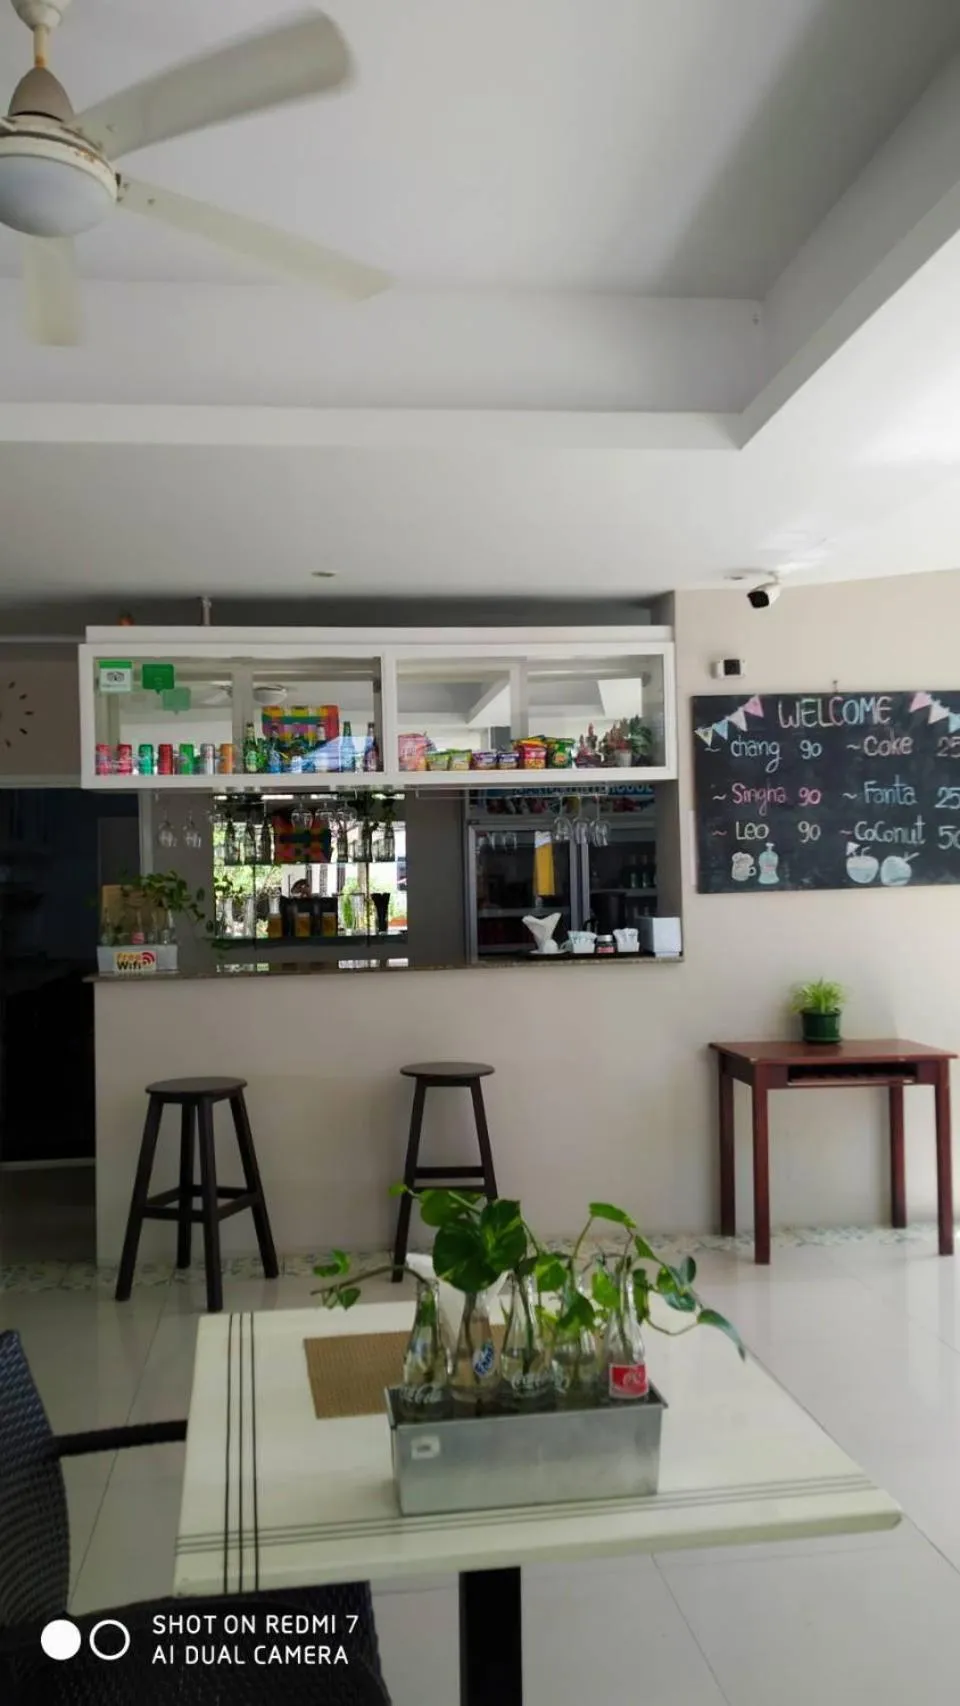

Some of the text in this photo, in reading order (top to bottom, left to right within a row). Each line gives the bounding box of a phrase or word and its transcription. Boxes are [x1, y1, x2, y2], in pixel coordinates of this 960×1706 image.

[778, 696, 893, 728] WELCOME
[799, 739, 823, 760] 90
[863, 728, 960, 758] Coke 25
[731, 779, 822, 816] Singha 90
[863, 774, 960, 809] Fanta 25
[797, 820, 821, 843] 90
